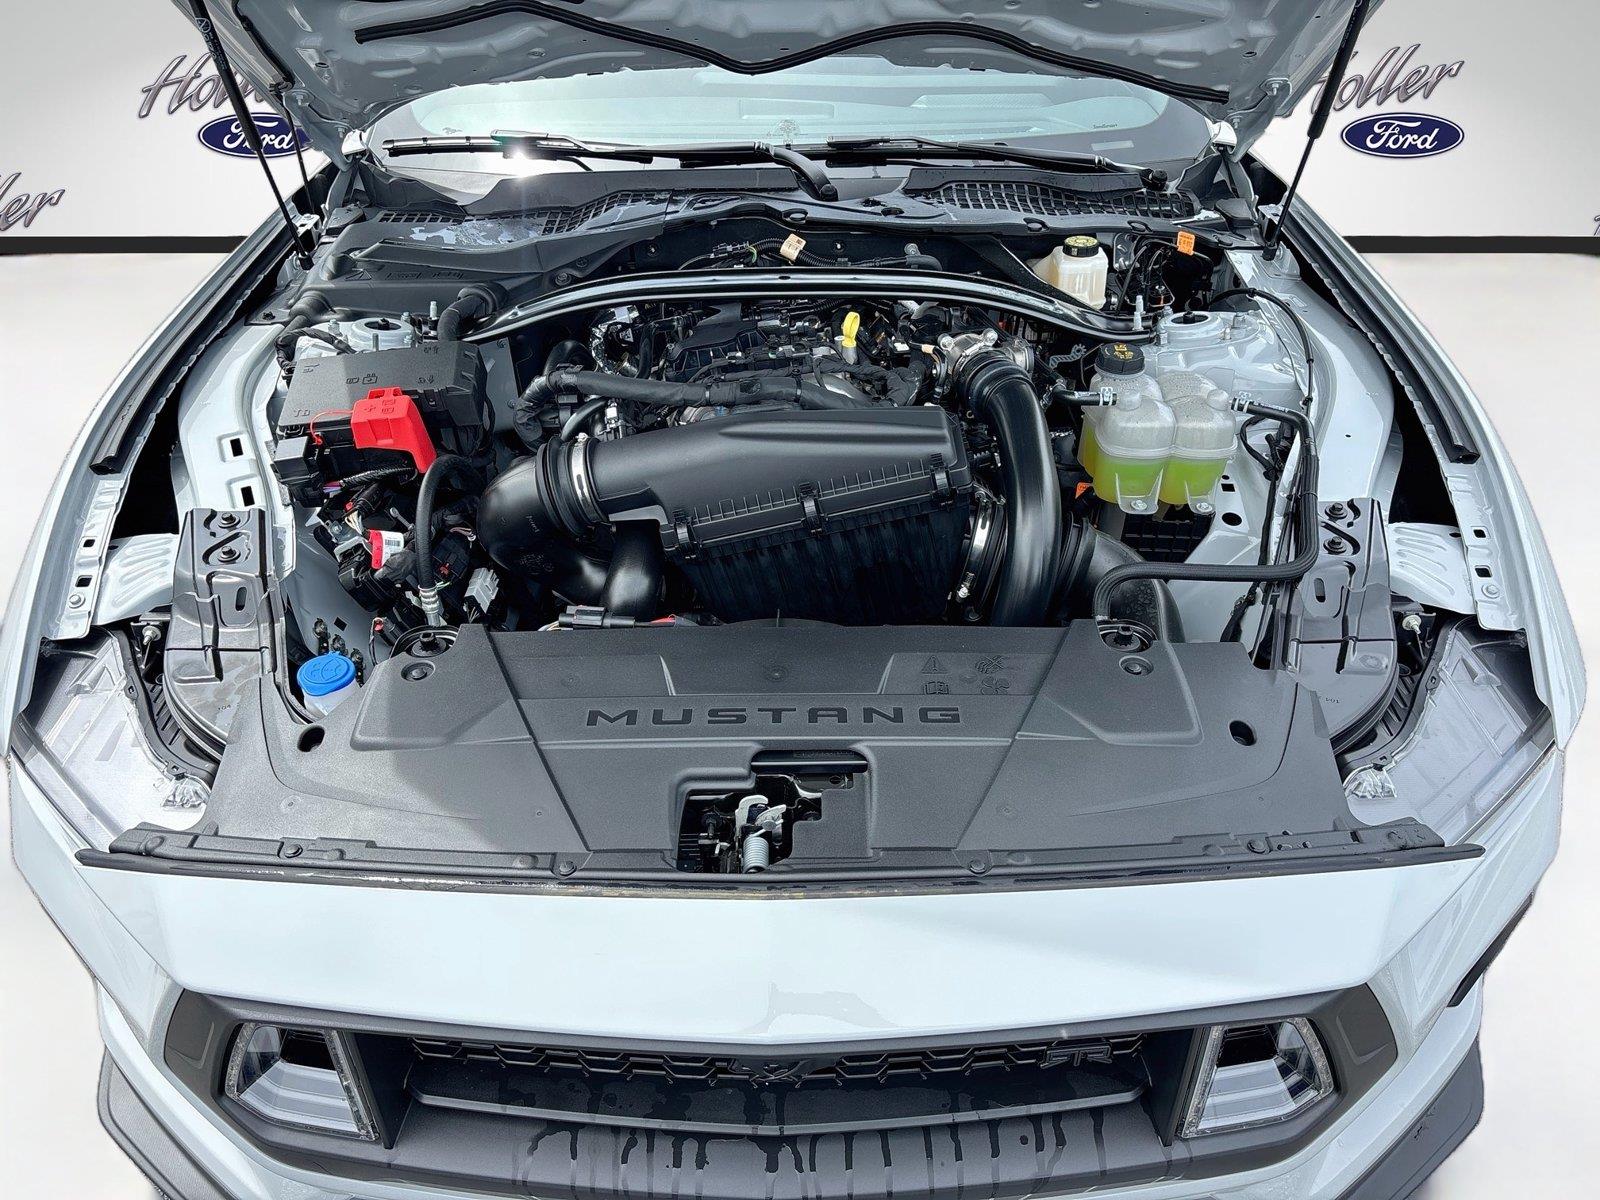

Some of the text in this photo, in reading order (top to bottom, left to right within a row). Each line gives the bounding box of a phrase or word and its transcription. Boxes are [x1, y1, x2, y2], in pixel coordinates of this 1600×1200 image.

[222, 119, 293, 150] Frd
[1365, 119, 1440, 150] Ford
[586, 705, 962, 727] MUSTANG
